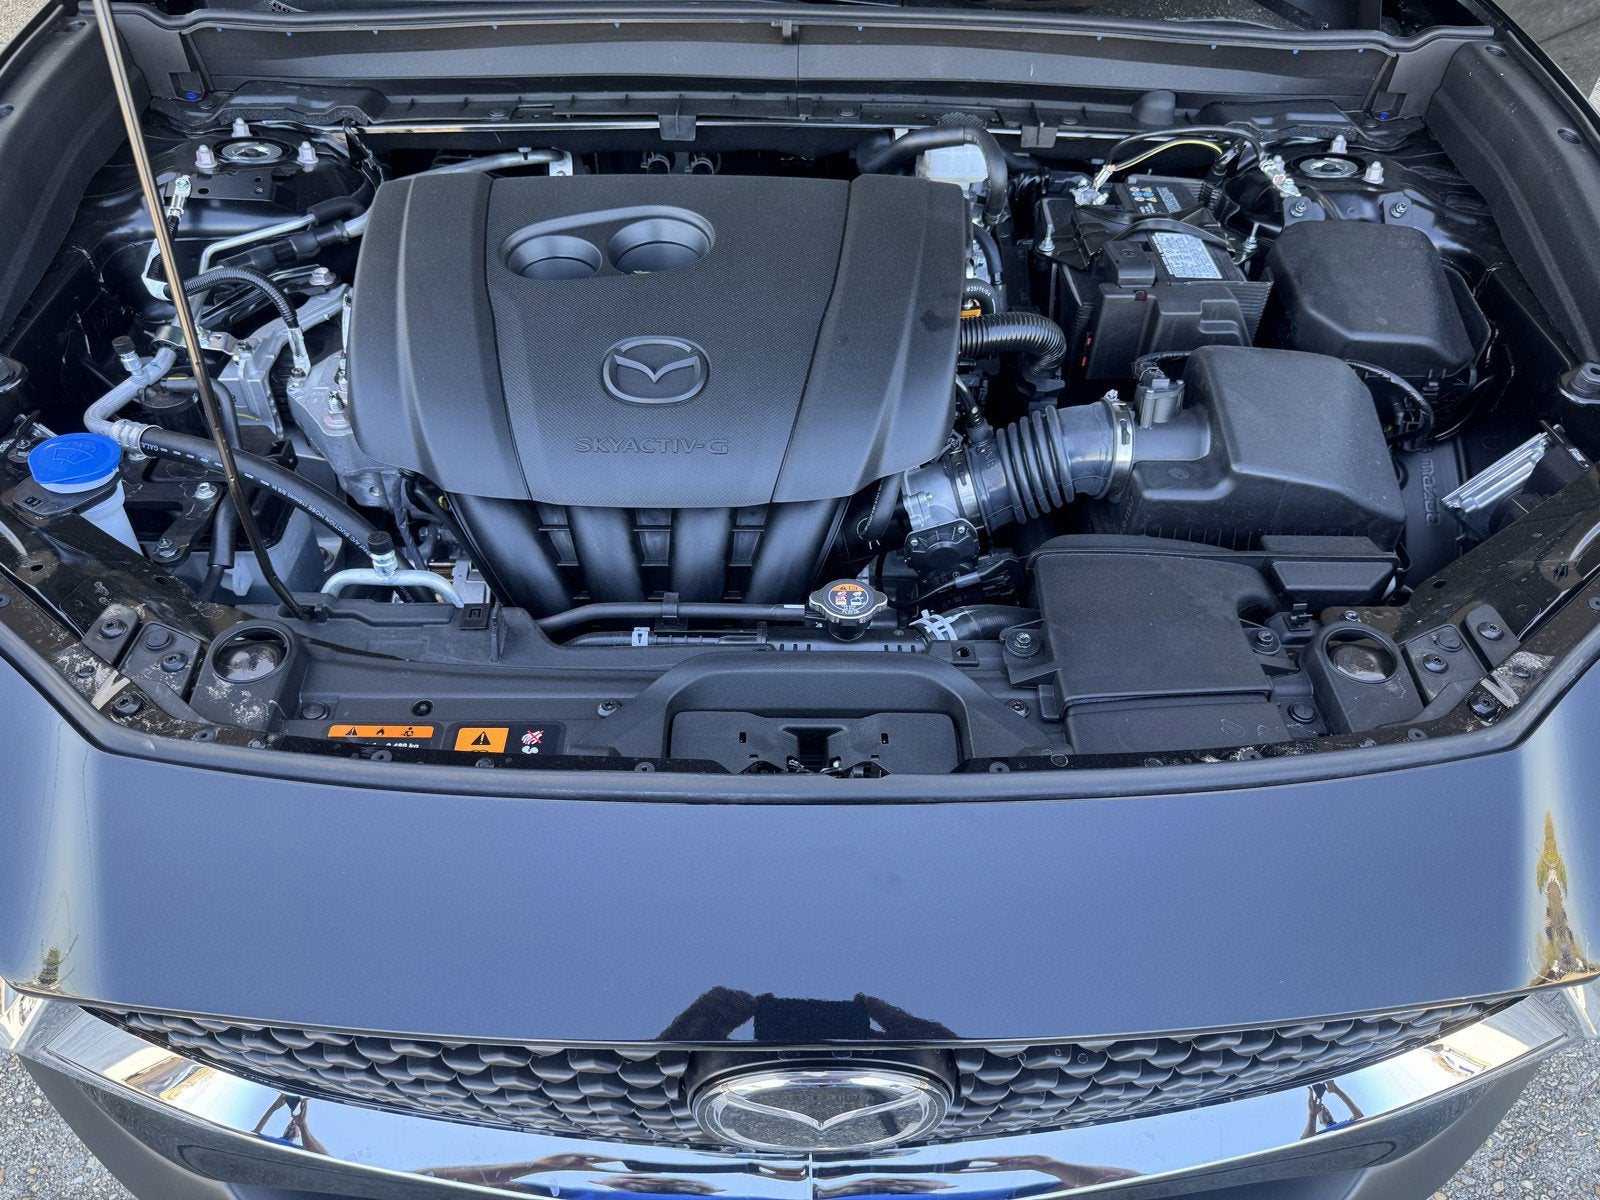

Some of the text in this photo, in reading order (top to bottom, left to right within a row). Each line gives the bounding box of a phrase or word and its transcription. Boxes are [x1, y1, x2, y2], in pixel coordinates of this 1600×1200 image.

[574, 437, 729, 455] SKYACTIV-G
[1420, 458, 1440, 527] mazda
[308, 505, 326, 519] HOSE
[325, 517, 350, 538] SUCTION
